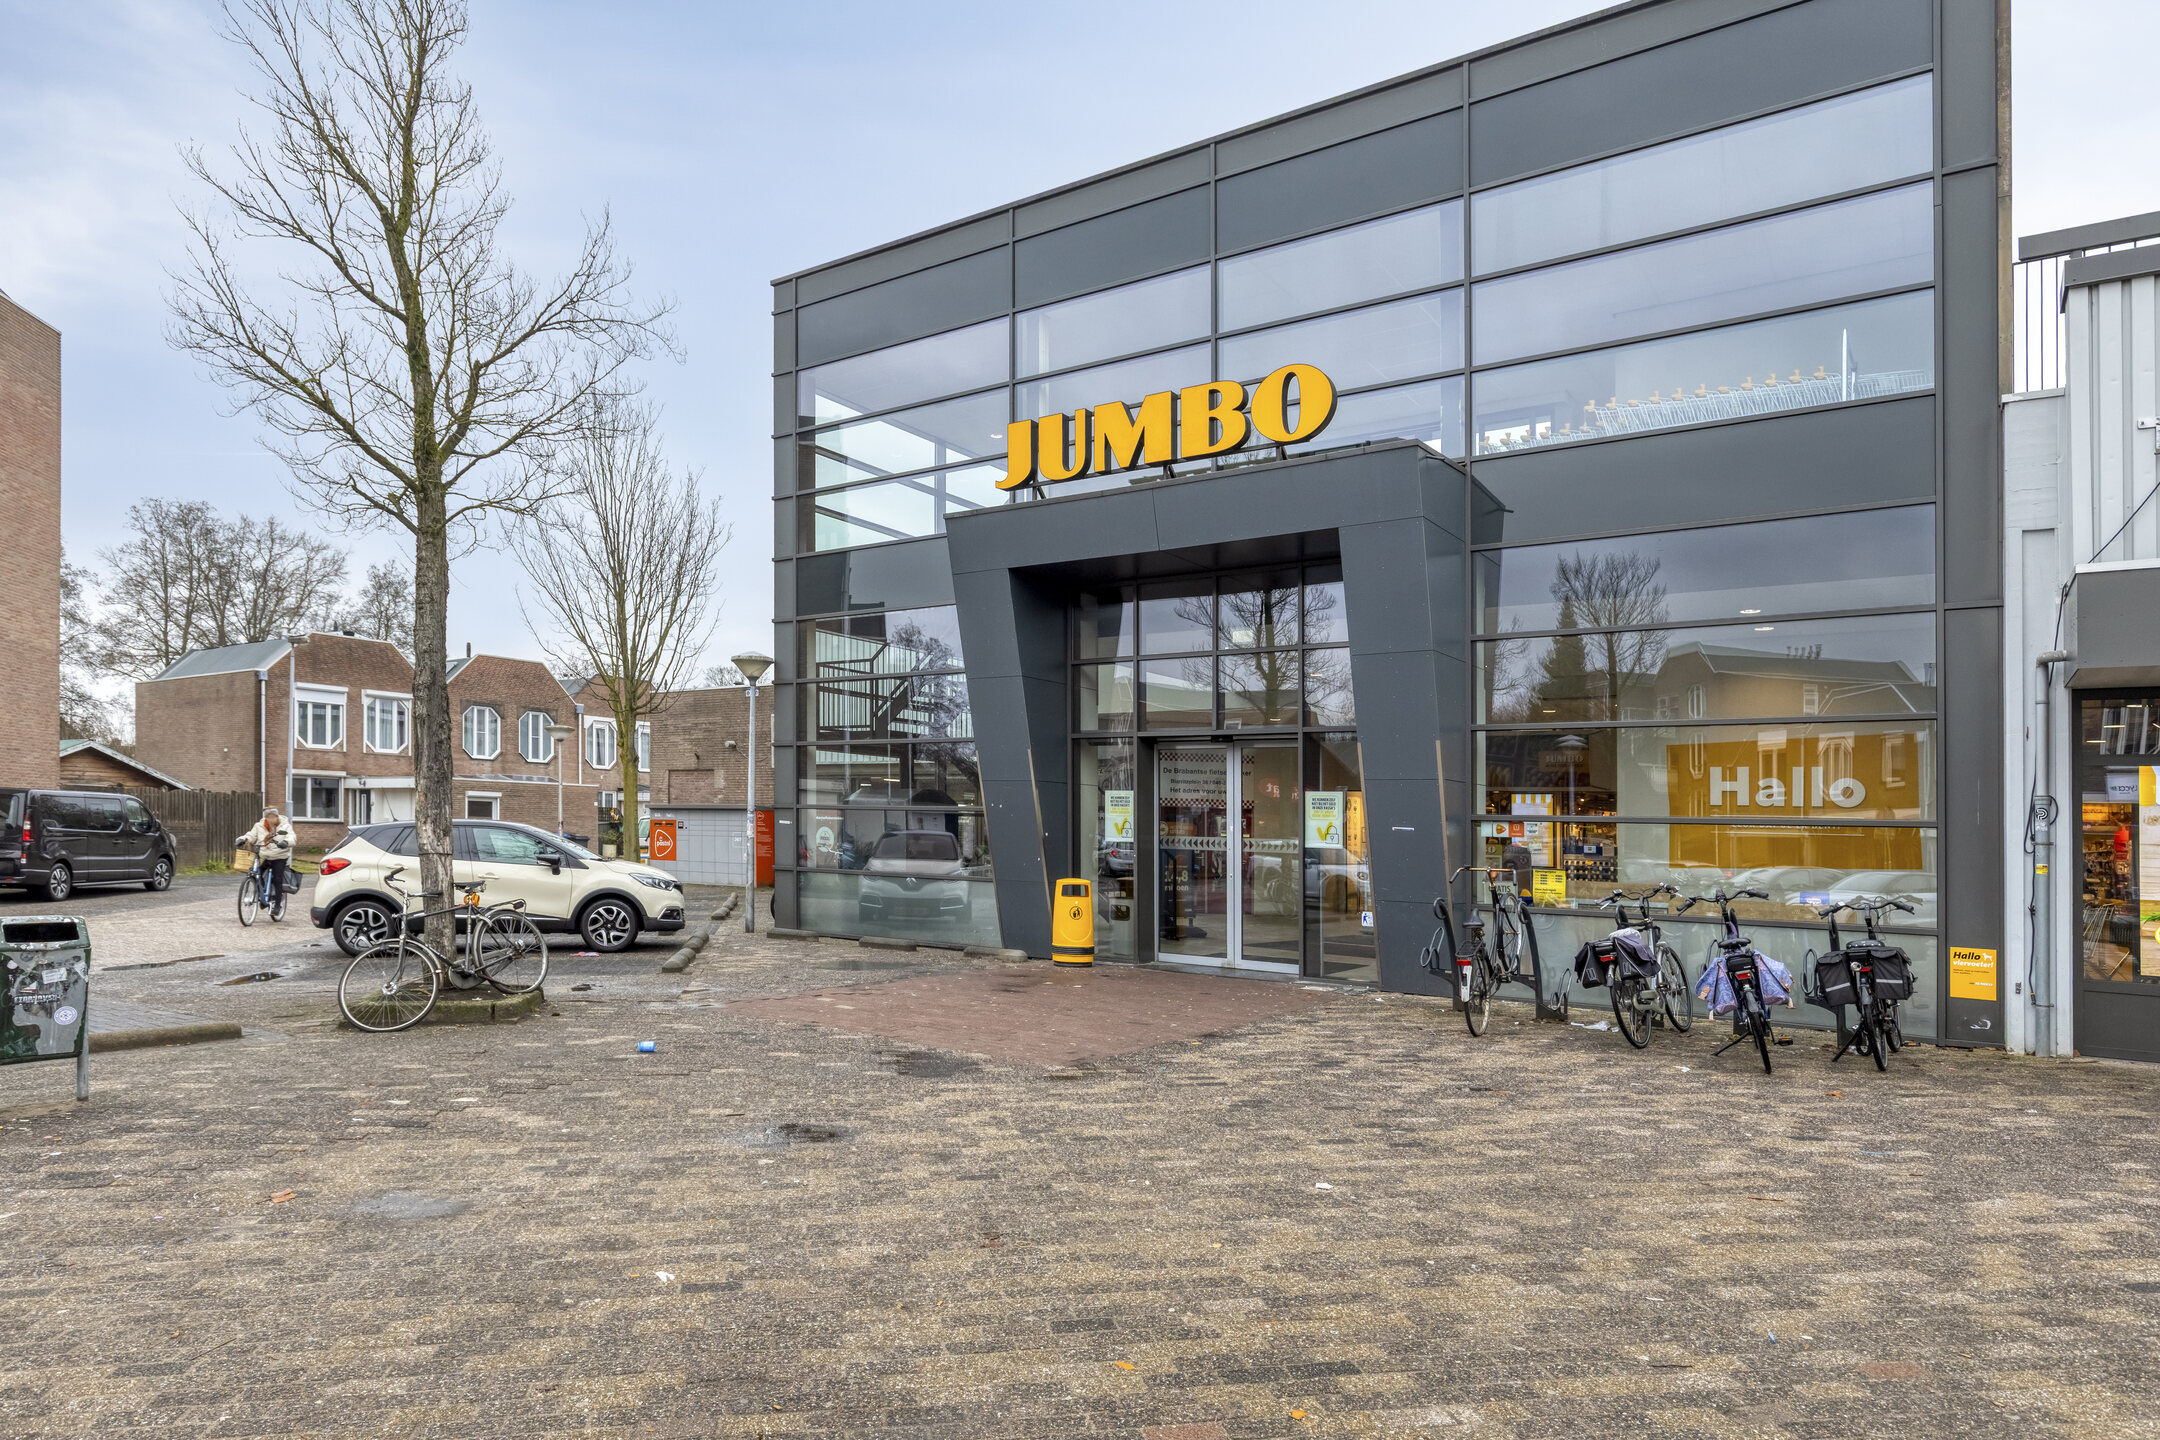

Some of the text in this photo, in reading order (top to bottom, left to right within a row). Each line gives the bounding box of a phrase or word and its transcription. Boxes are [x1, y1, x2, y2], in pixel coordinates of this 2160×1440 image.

[995, 363, 1337, 491] JUMBO
[1174, 767, 1208, 775] Brabantse
[1709, 766, 1867, 808] Hallo
[1953, 952, 1981, 960] Hallo
[1952, 960, 1994, 968] viervoeter!
